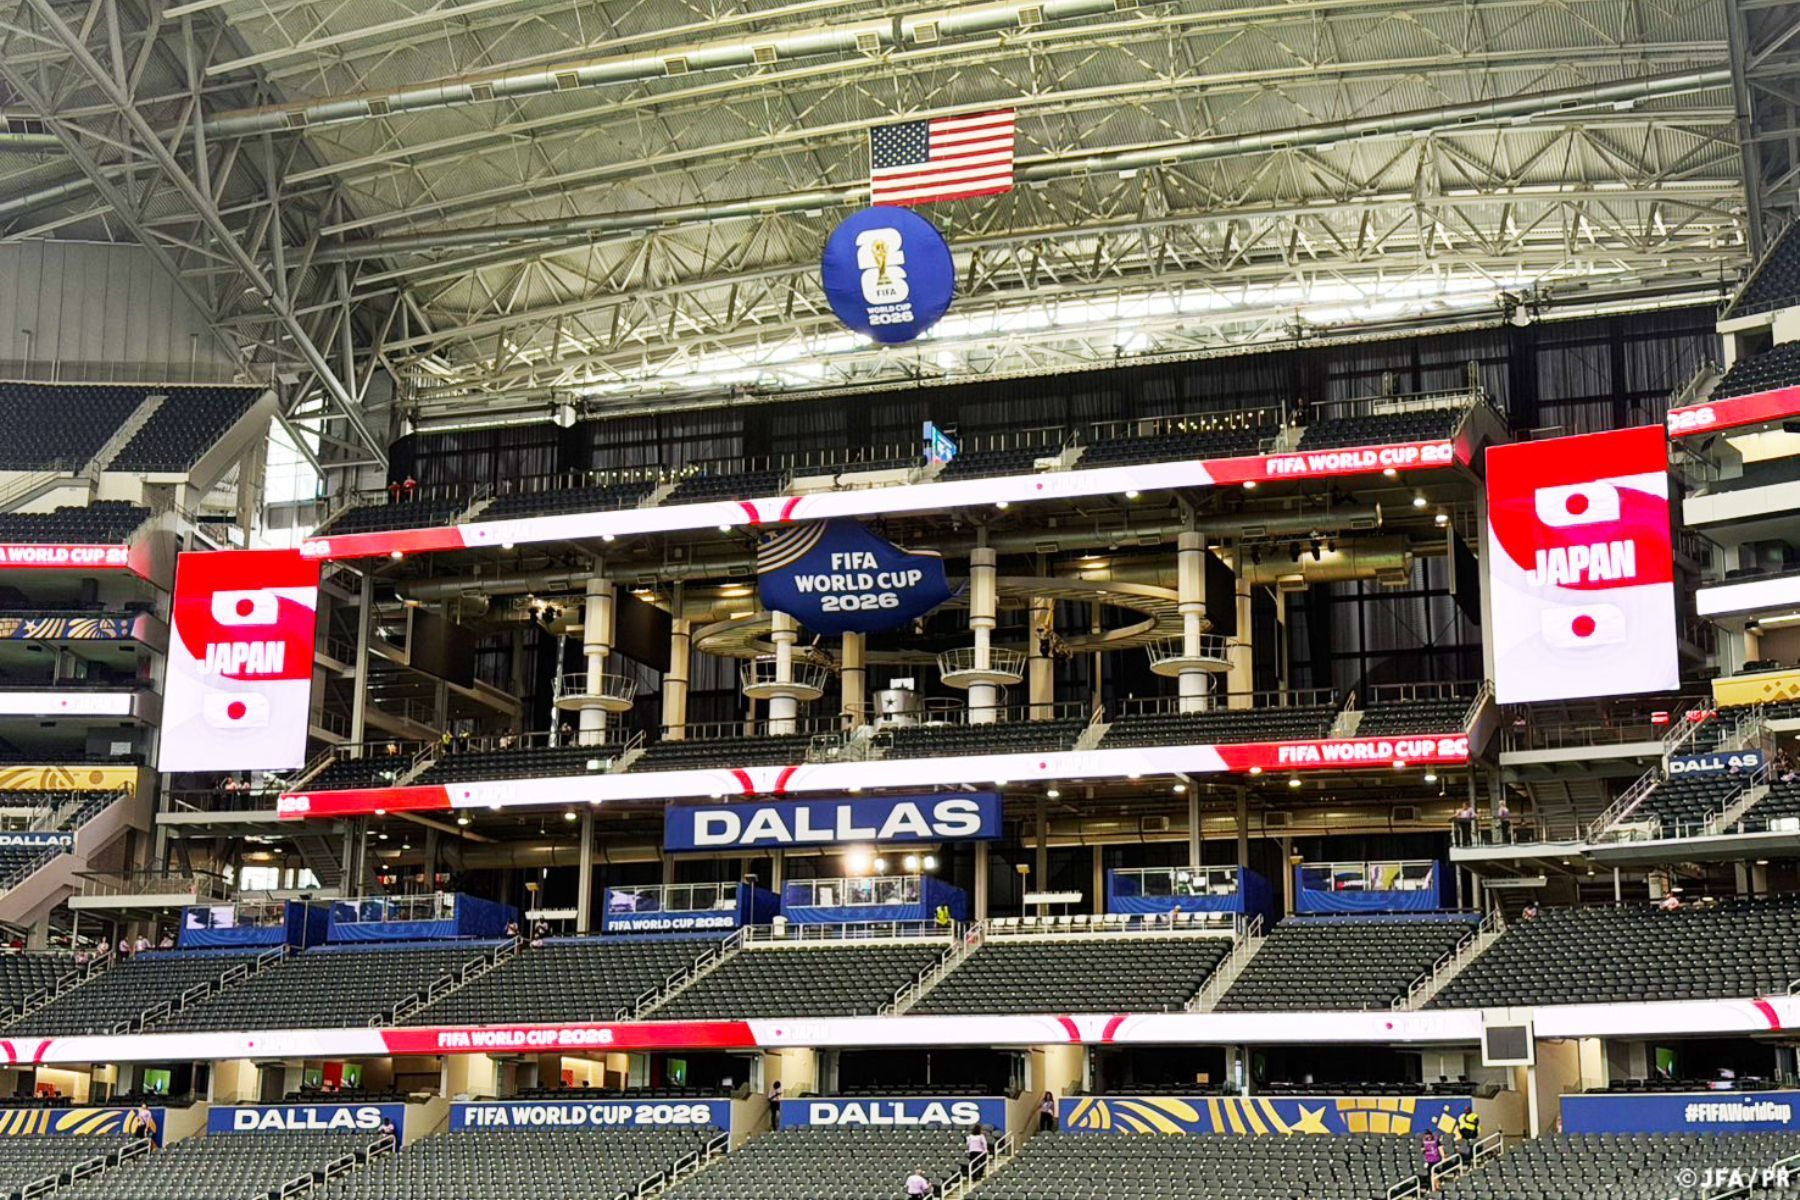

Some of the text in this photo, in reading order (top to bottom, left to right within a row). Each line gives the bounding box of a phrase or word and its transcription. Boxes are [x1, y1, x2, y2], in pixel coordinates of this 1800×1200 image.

[876, 288, 897, 297] FIFA
[866, 303, 912, 315] WORLD CUP
[868, 310, 914, 326] 2026
[1266, 456, 1307, 475] FIFA
[1308, 450, 1377, 471] WORLD
[1379, 447, 1419, 465] CUP
[8, 548, 69, 562] WORLD
[71, 548, 105, 563] CUP
[831, 552, 878, 571] FIFA
[1525, 539, 1636, 587] JAPAN
[794, 569, 922, 592] WORLD CUP
[820, 592, 899, 612] 2026
[196, 640, 285, 675] JAPAN
[1278, 745, 1320, 763] FIFA
[1322, 742, 1393, 760] WORLD
[1395, 740, 1435, 757] CUP
[1670, 754, 1758, 773] DALLAS
[694, 799, 981, 845] DALLAS
[608, 917, 734, 931] FIFA WORLD CUP 2026
[438, 1029, 613, 1047] FIFA WORLD CUP 2026
[233, 1107, 382, 1130] DALLAS
[464, 1104, 710, 1126] FIFA WORLD CUP 2026
[809, 1101, 981, 1125] DALLAS
[1685, 1102, 1791, 1124] #FIFAWorldCup
